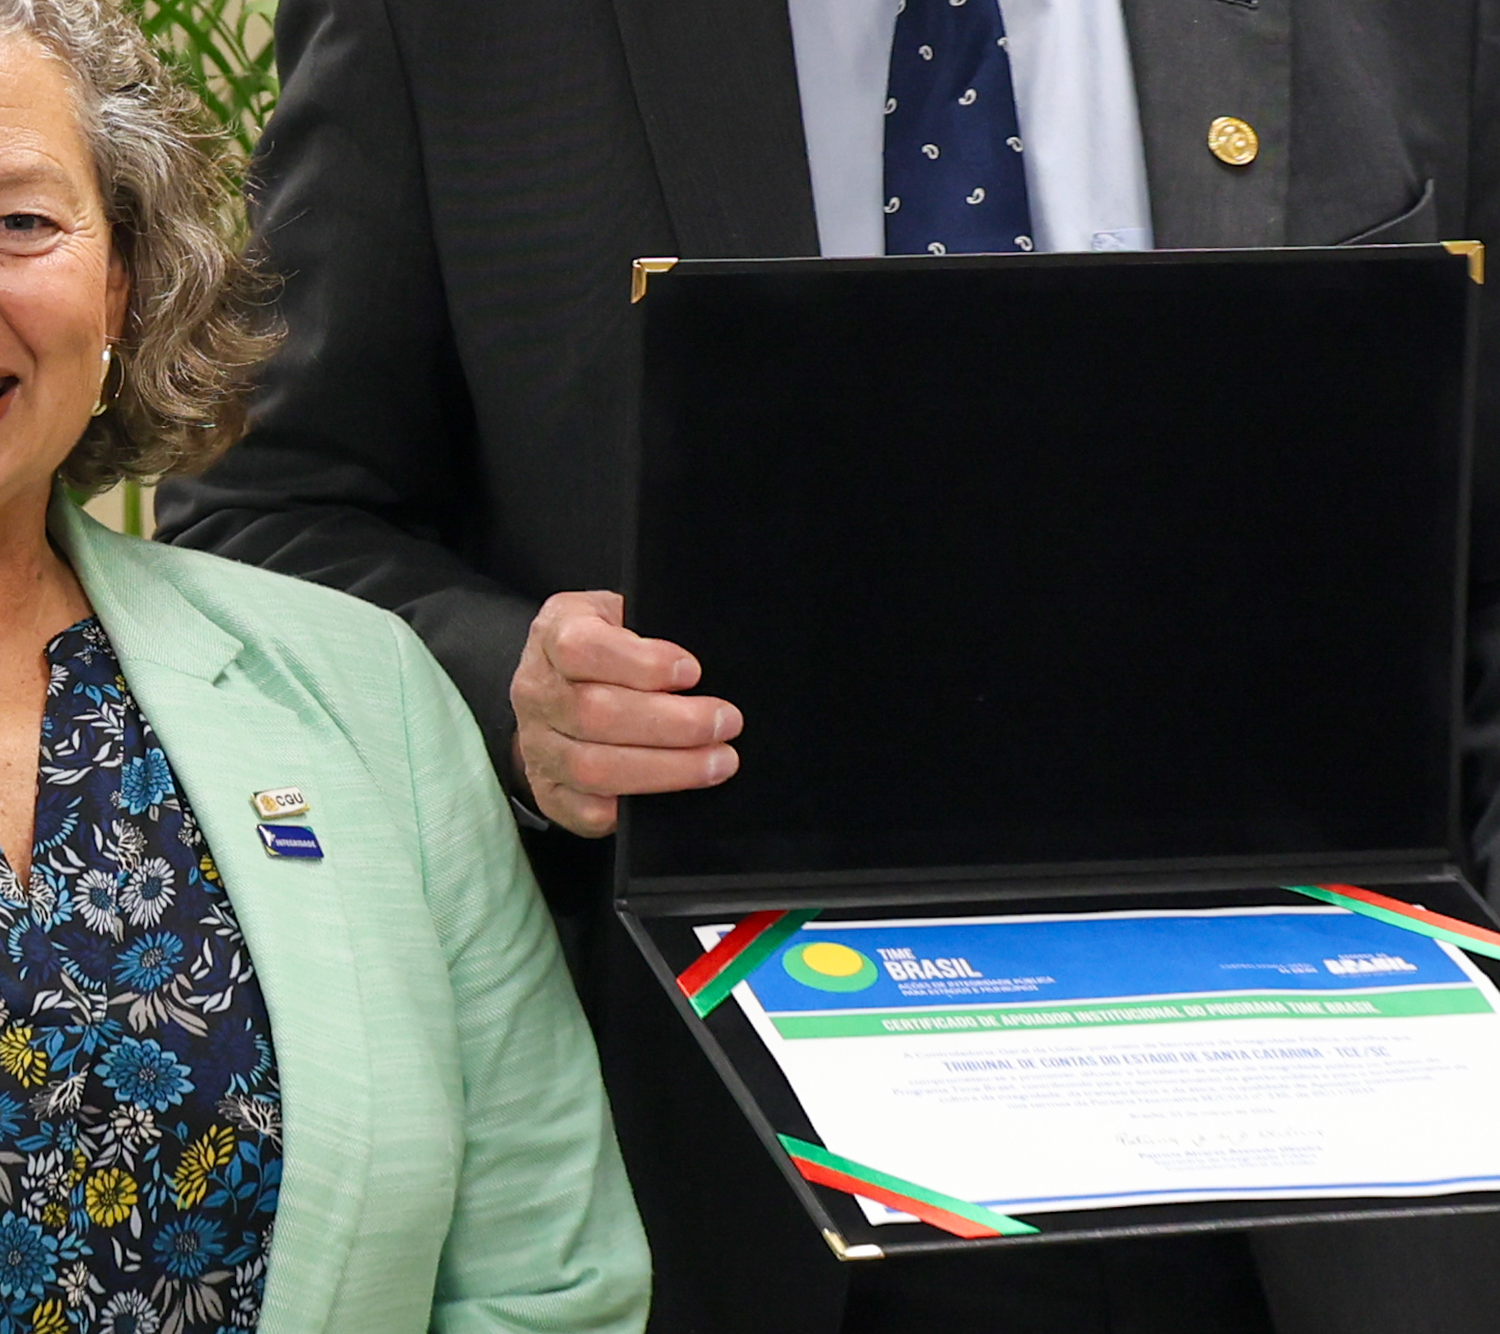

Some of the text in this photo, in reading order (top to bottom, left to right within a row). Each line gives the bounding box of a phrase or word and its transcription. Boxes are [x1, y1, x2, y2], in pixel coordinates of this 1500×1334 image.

[276, 793, 304, 806] CGU
[876, 947, 916, 961] TIME
[883, 958, 983, 981] BRASIL
[882, 1001, 1381, 1031] CERTIFICADO DE APOIADOR INSTITUCIONAL DO PROGRAMA TIME BRASIL
[944, 1059, 1013, 1072] TRIBUNAL
[1017, 1059, 1035, 1069] DE
[1039, 1056, 1098, 1068] CONTAS
[1098, 1055, 1121, 1066] DO
[1121, 1052, 1179, 1065] ESTADO
[1179, 1051, 1198, 1063] DE
[1202, 1050, 1251, 1061] SANTA
[1252, 1047, 1324, 1059] CATARINA
[1334, 1046, 1390, 1058] TCE/SC
